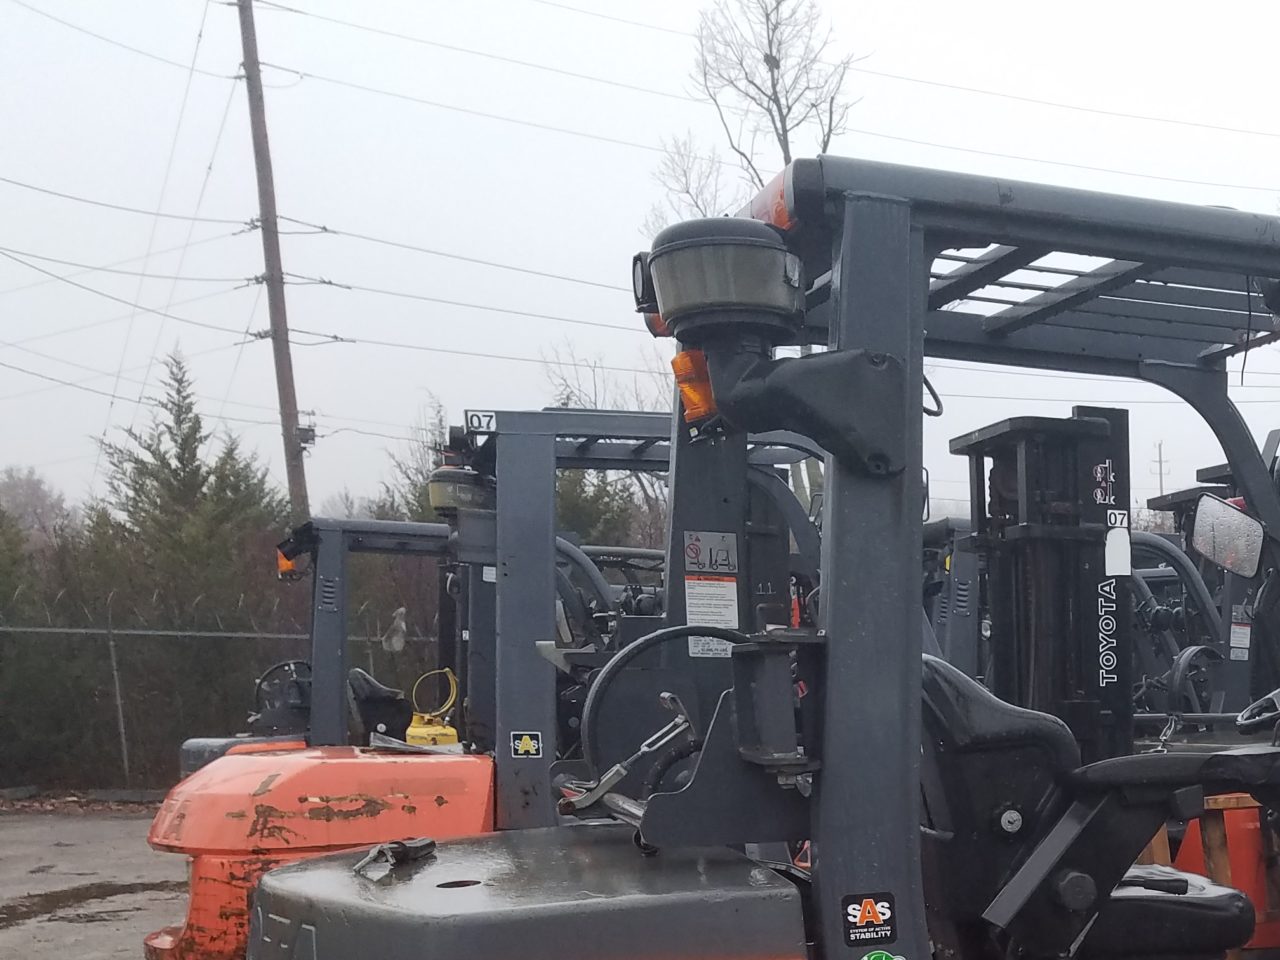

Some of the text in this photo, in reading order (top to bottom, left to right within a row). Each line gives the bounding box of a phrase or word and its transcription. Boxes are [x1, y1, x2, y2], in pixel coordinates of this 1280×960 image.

[470, 413, 494, 430] 07
[1108, 512, 1127, 526] 07
[1098, 578, 1118, 687] TOYOTA
[514, 735, 539, 754] SAS
[847, 898, 892, 926] SAS
[850, 930, 892, 940] STABILITY
